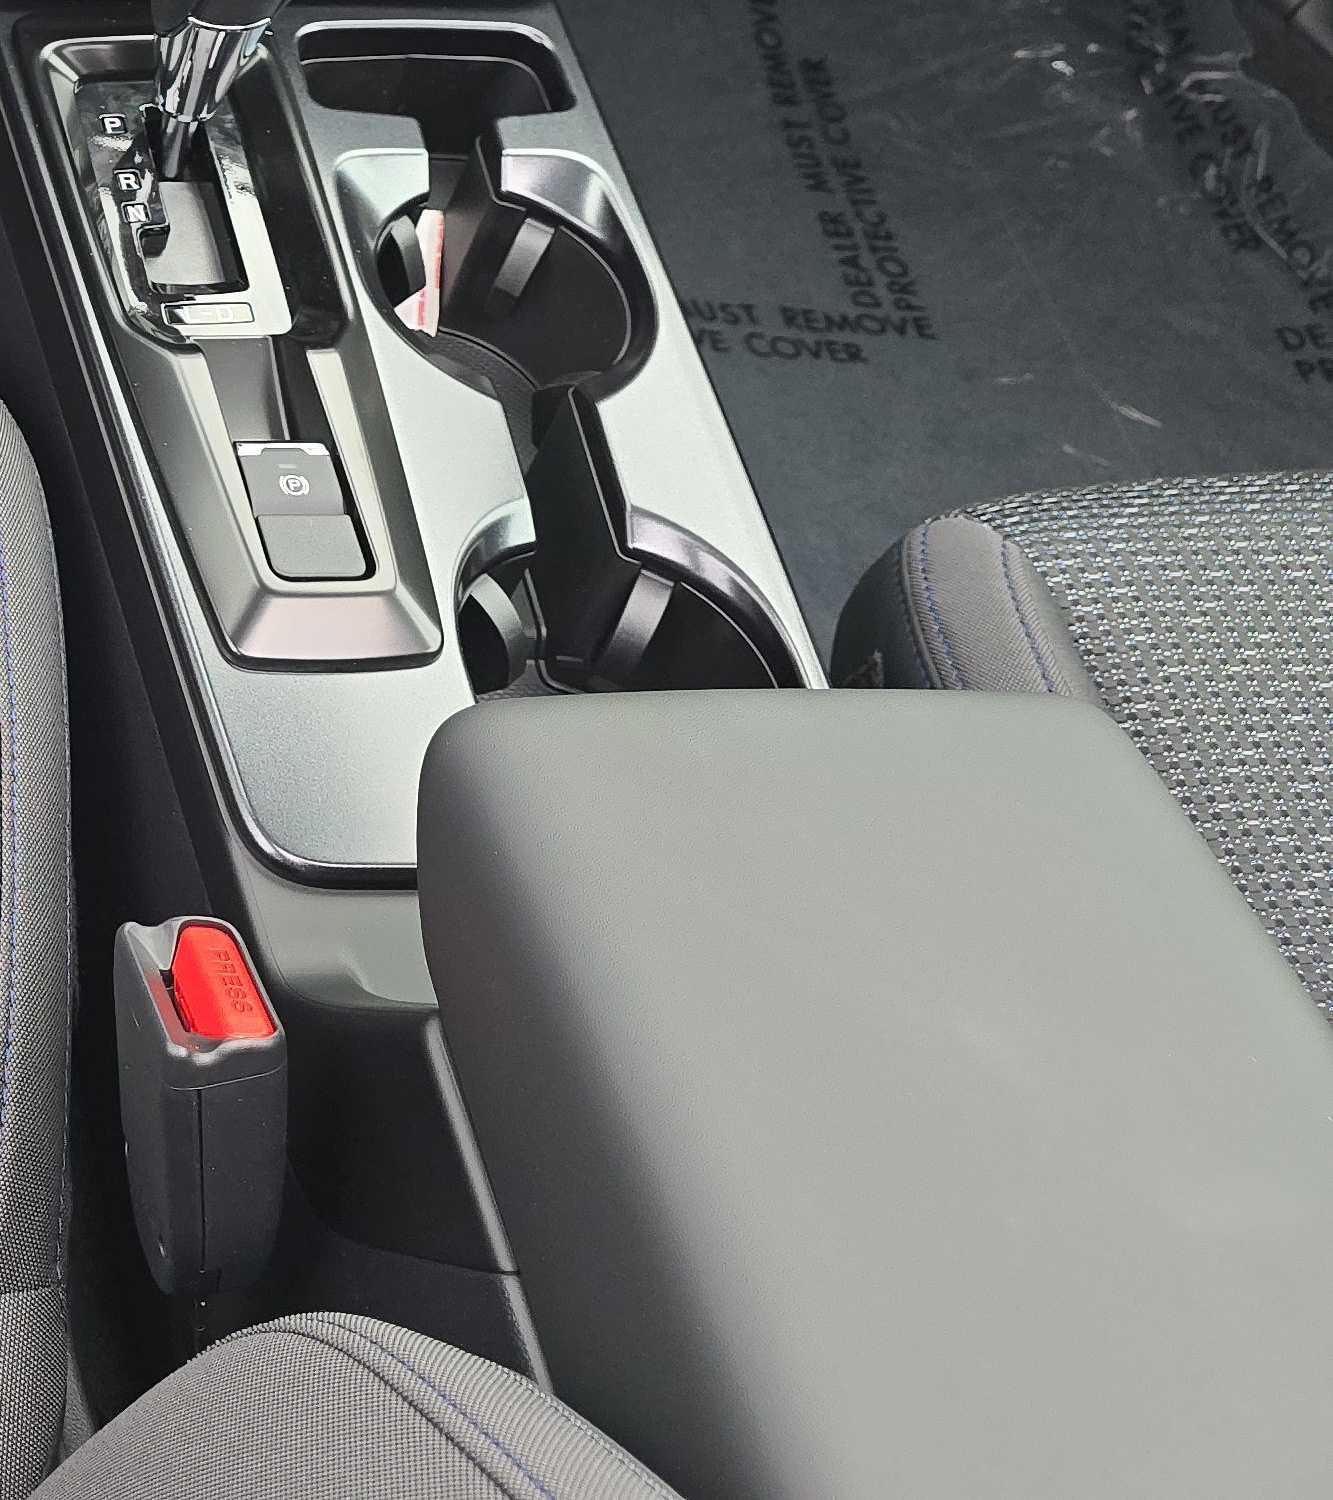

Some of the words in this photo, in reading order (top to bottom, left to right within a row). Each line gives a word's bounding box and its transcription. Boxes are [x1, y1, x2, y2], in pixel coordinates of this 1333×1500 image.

[104, 117, 122, 134] P
[782, 117, 833, 194] MUST
[119, 173, 138, 190] R
[127, 204, 147, 222] N
[818, 209, 882, 309] DEALER
[780, 304, 937, 341] REMOVE
[742, 330, 868, 364] COVER
[212, 947, 253, 1013] PRESS
